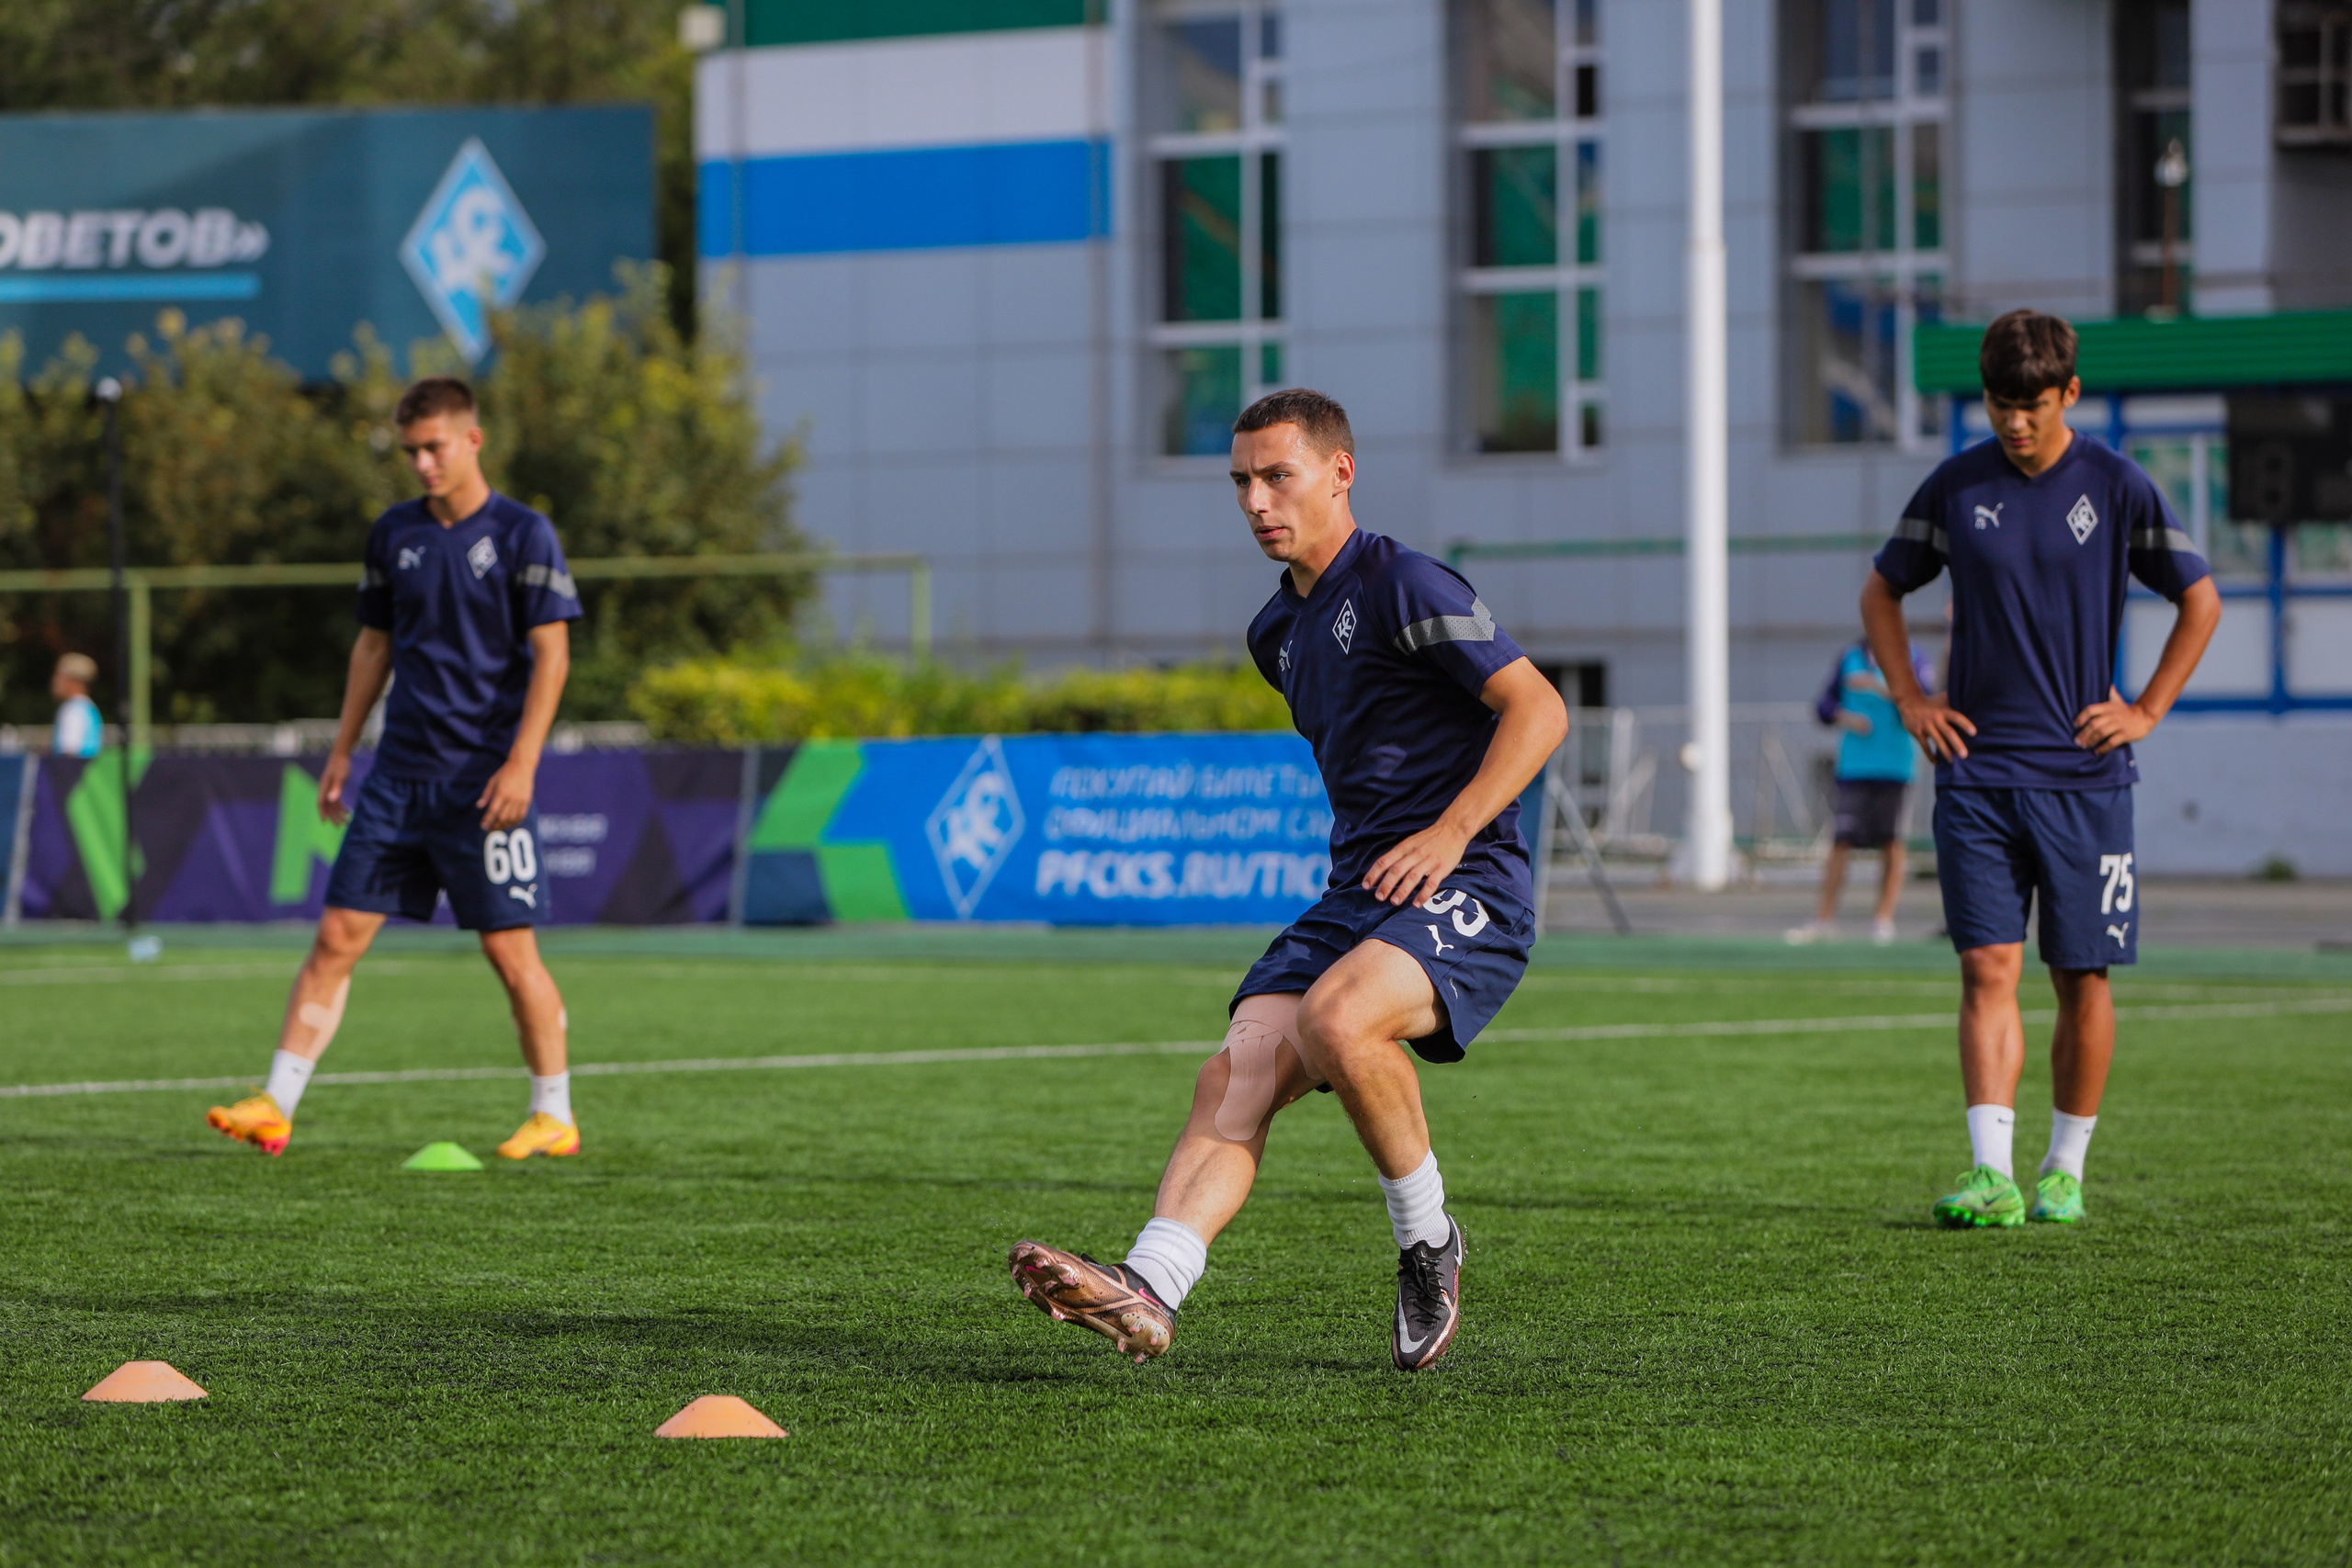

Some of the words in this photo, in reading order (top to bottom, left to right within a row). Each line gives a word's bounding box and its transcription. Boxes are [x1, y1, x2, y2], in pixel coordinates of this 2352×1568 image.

[483, 828, 537, 885] 60
[1035, 850, 1330, 899] PFCKS.RU/TIC
[2099, 852, 2133, 915] 75
